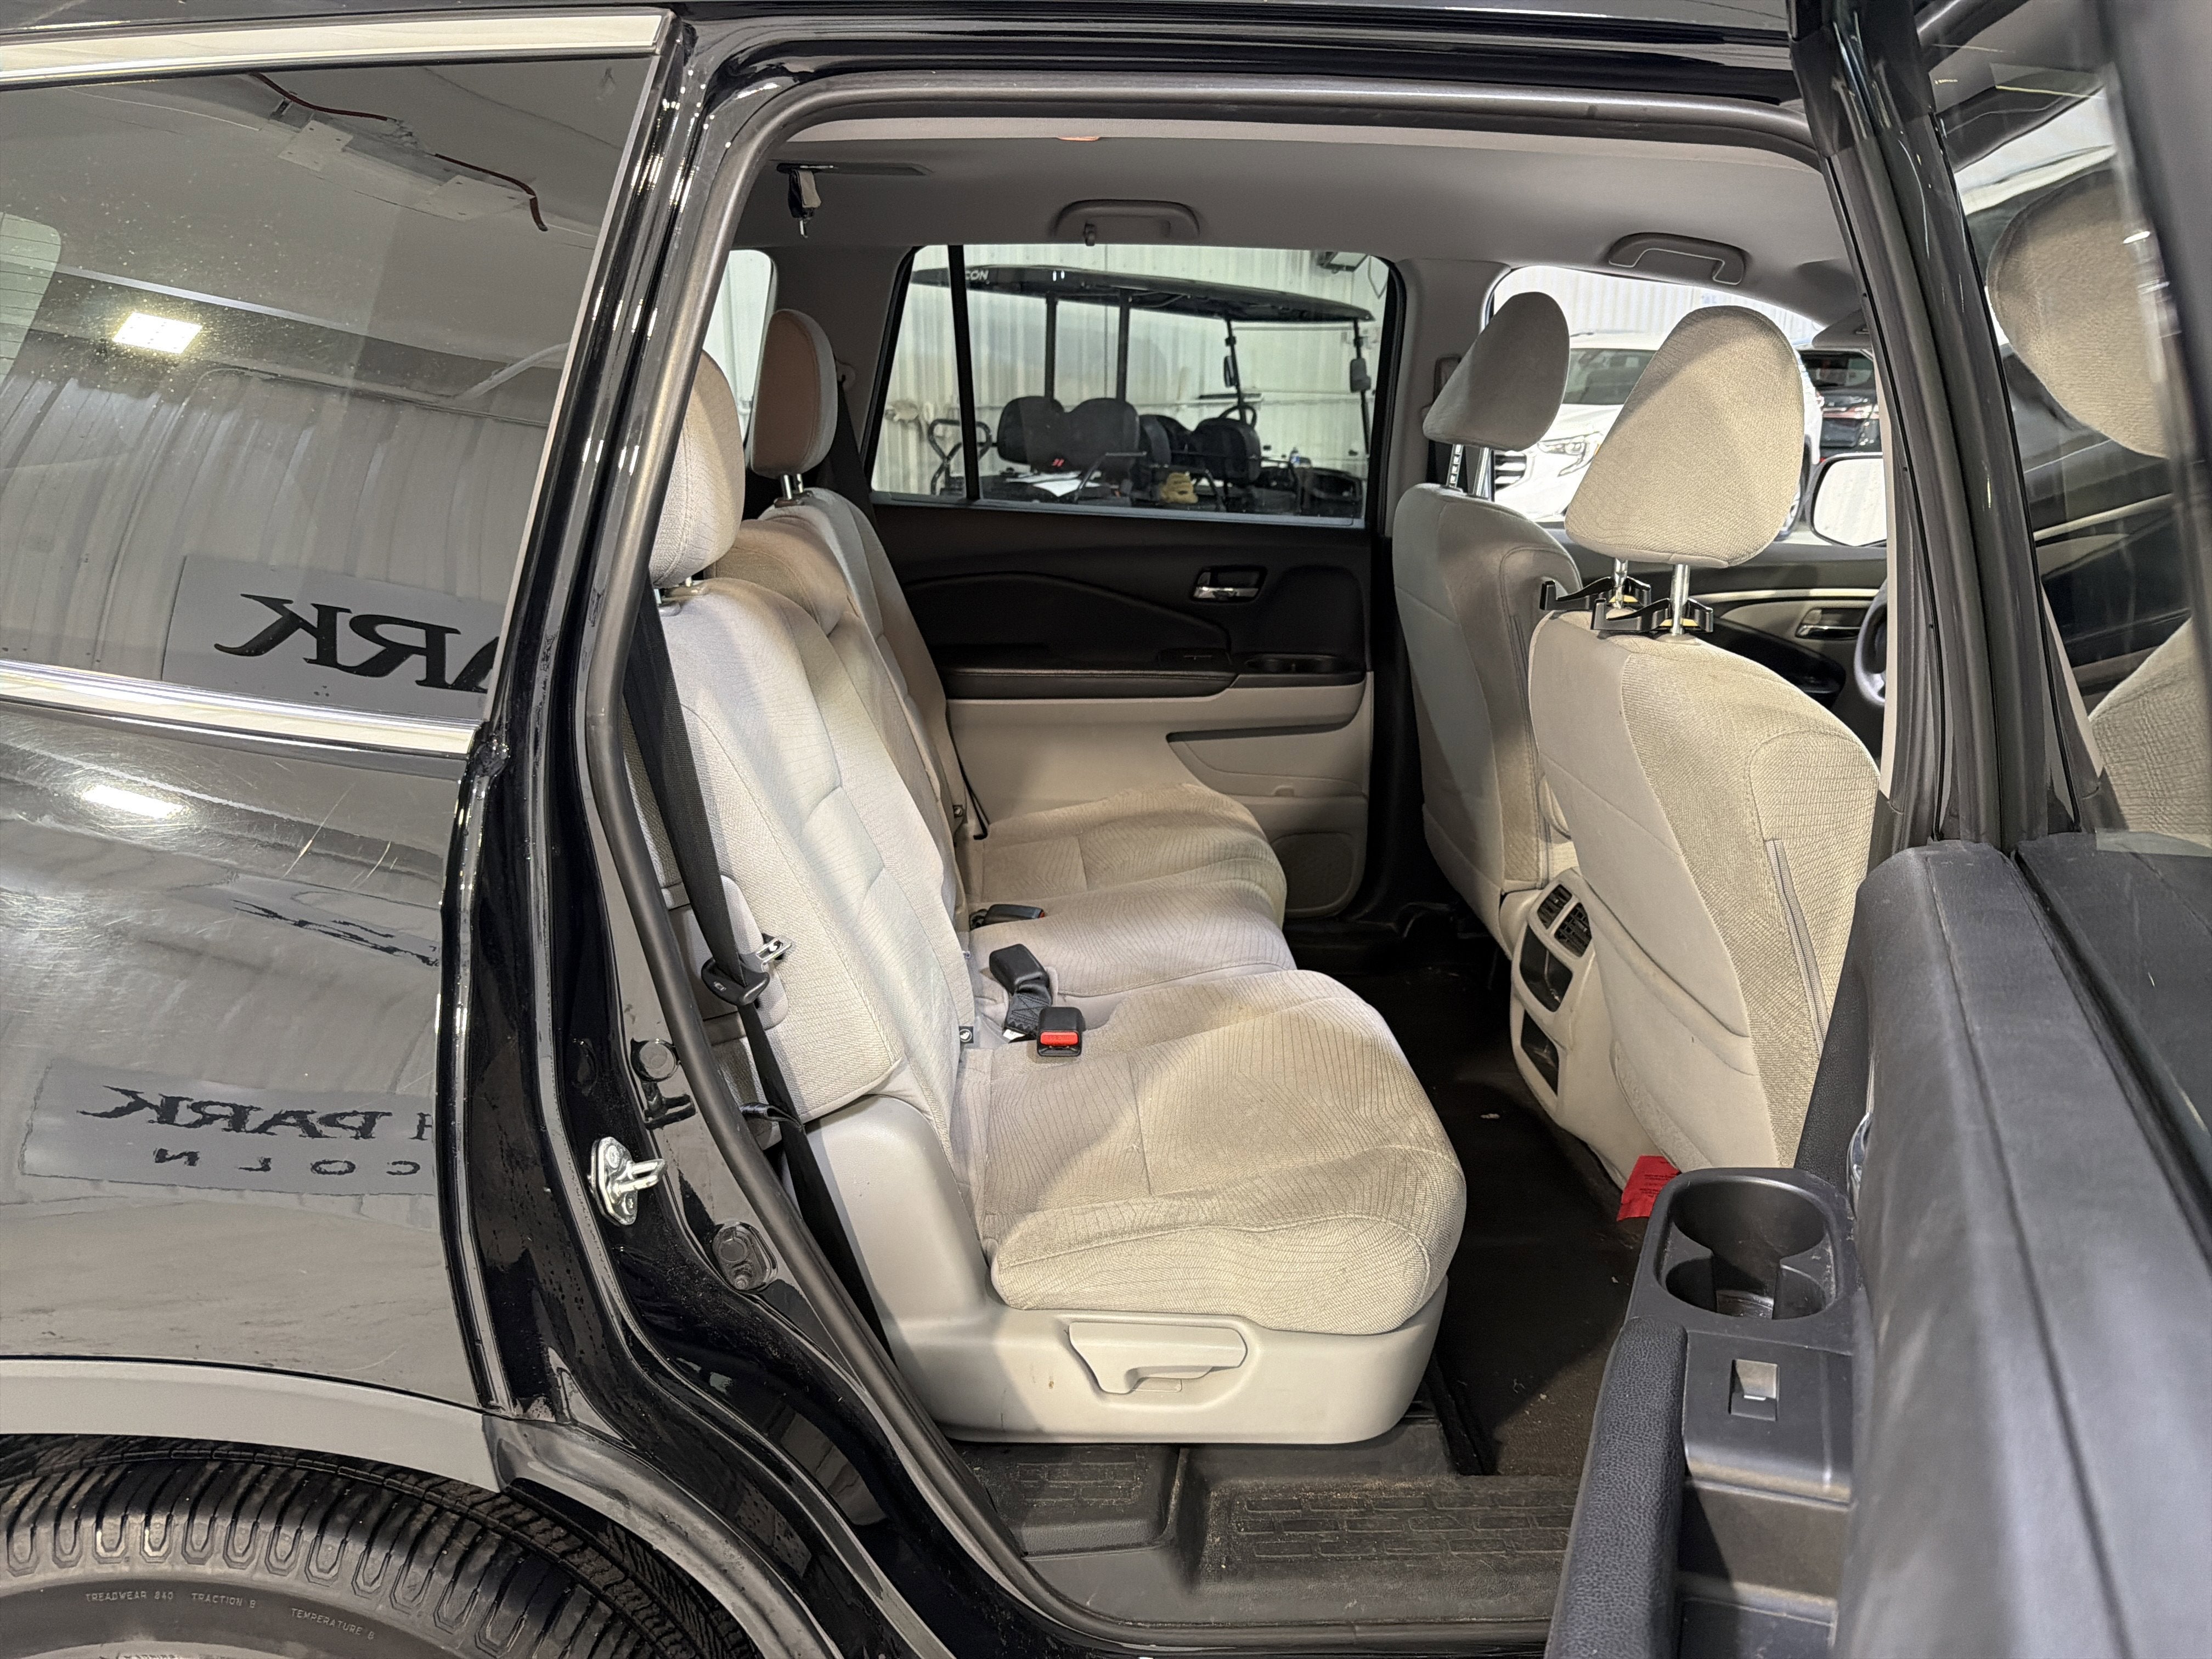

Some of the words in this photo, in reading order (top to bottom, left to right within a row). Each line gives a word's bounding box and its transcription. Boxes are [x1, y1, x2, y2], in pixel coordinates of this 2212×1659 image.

[86, 1591, 146, 1601] TREADWEAR
[191, 1593, 242, 1606] TRACTION
[291, 1608, 363, 1635] TEMPERATURE
